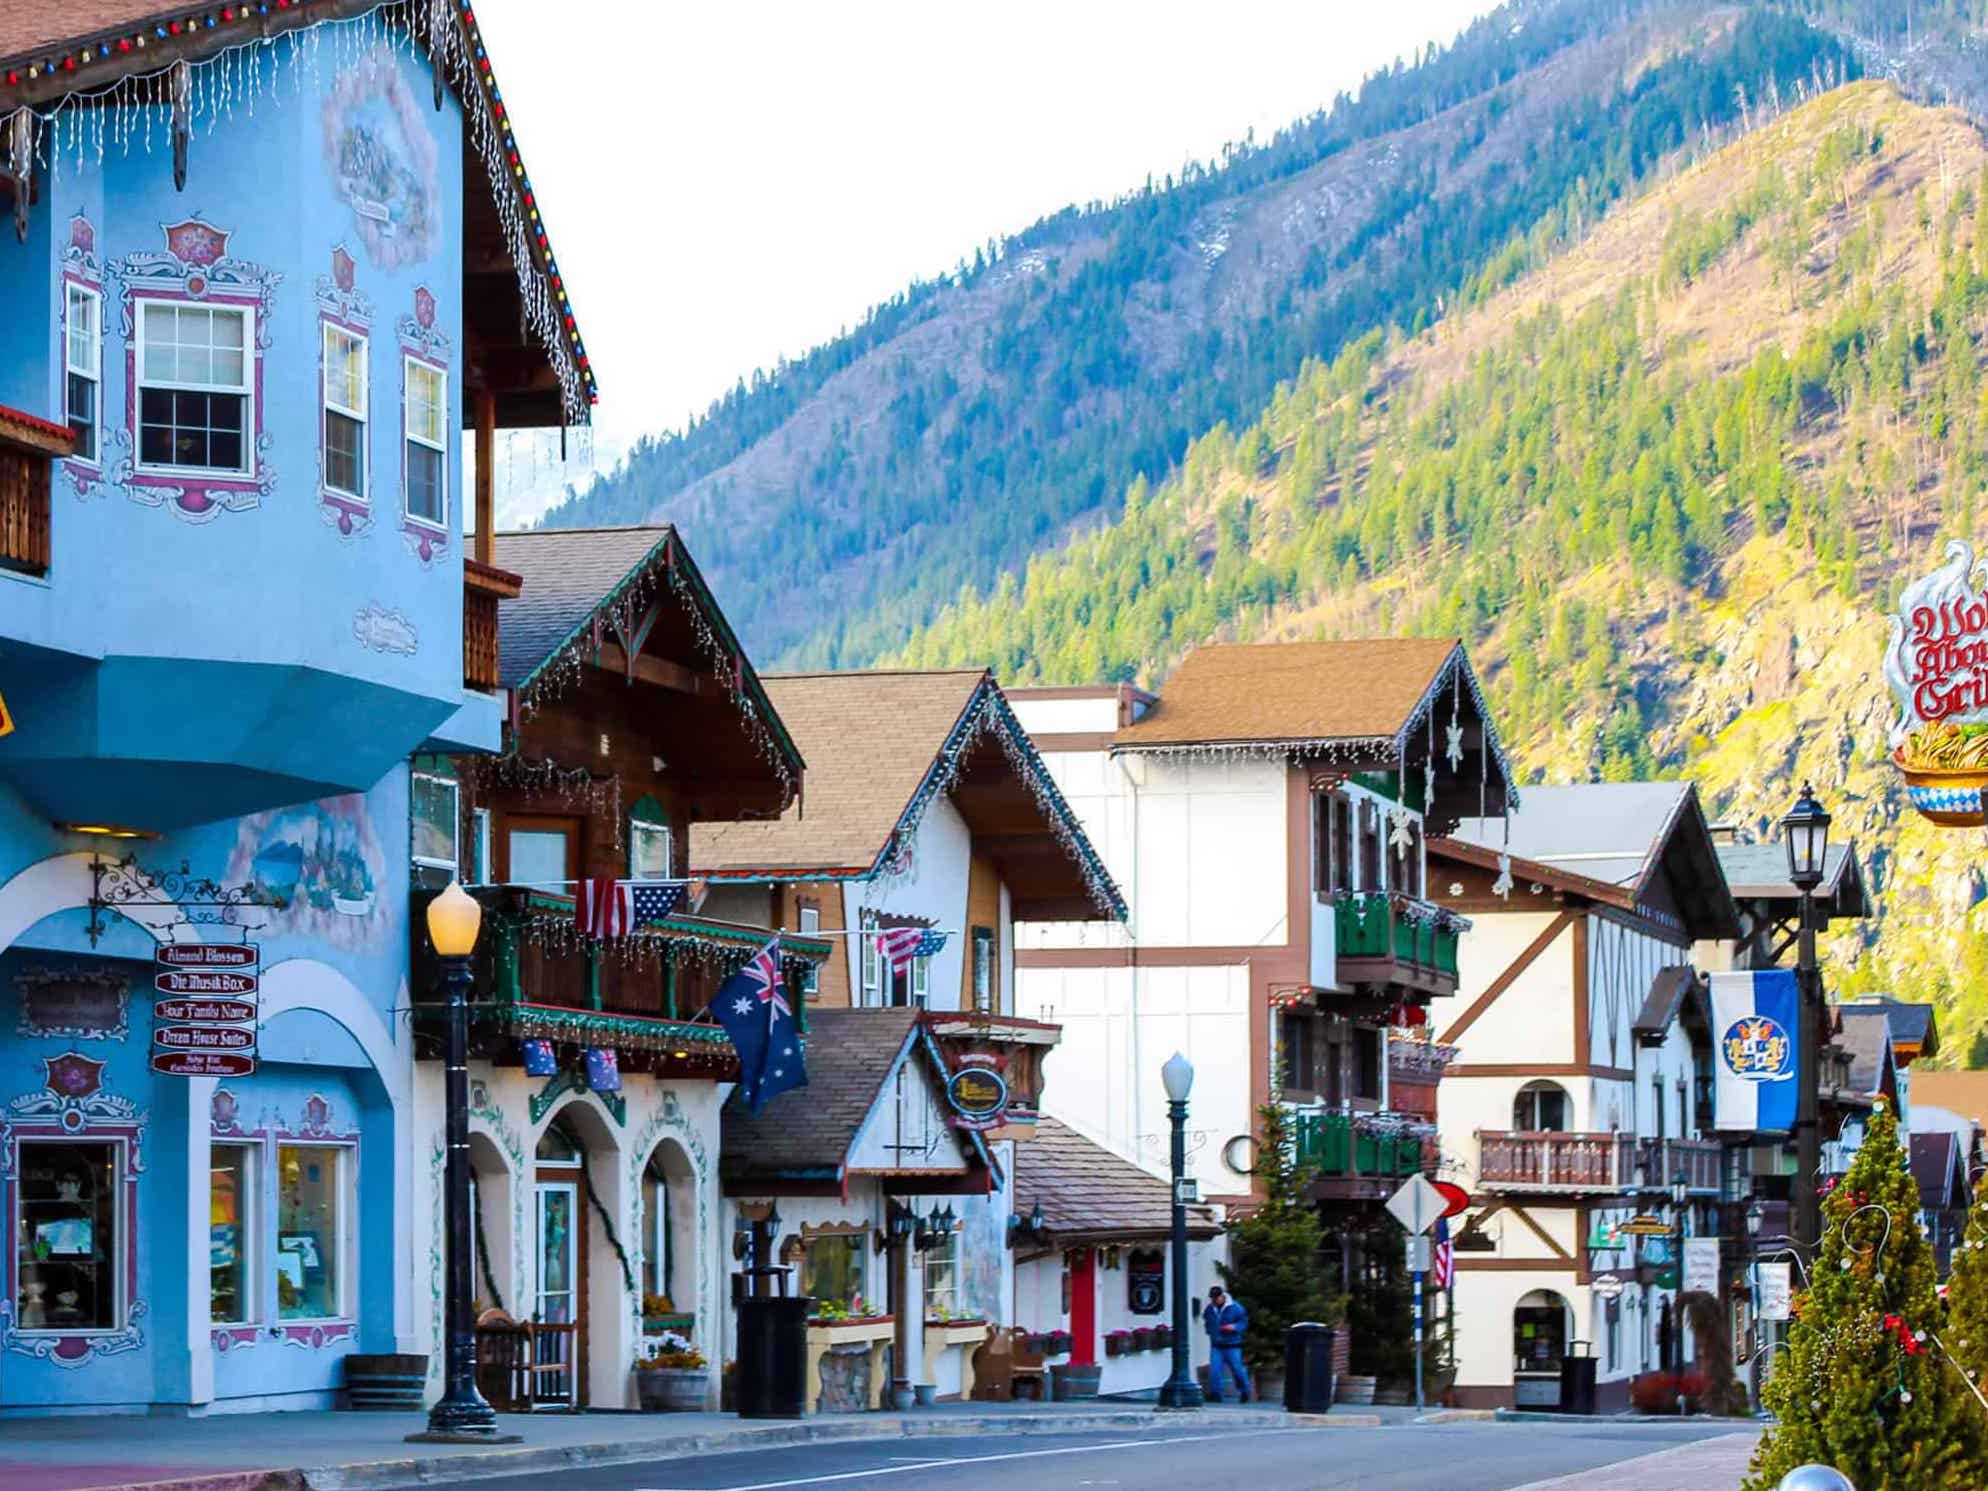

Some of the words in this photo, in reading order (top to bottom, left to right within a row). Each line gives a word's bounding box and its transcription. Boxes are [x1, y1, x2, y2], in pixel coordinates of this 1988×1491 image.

[1911, 590, 1988, 646] Wo
[167, 948, 204, 962] Almond
[206, 948, 245, 962] Blossom
[170, 974, 186, 989] Die
[223, 975, 246, 991] Box
[185, 1003, 219, 1018] Family
[221, 1004, 249, 1018] Name
[163, 1029, 190, 1044] Dream
[192, 1030, 218, 1045] House
[219, 1031, 247, 1045] Suites
